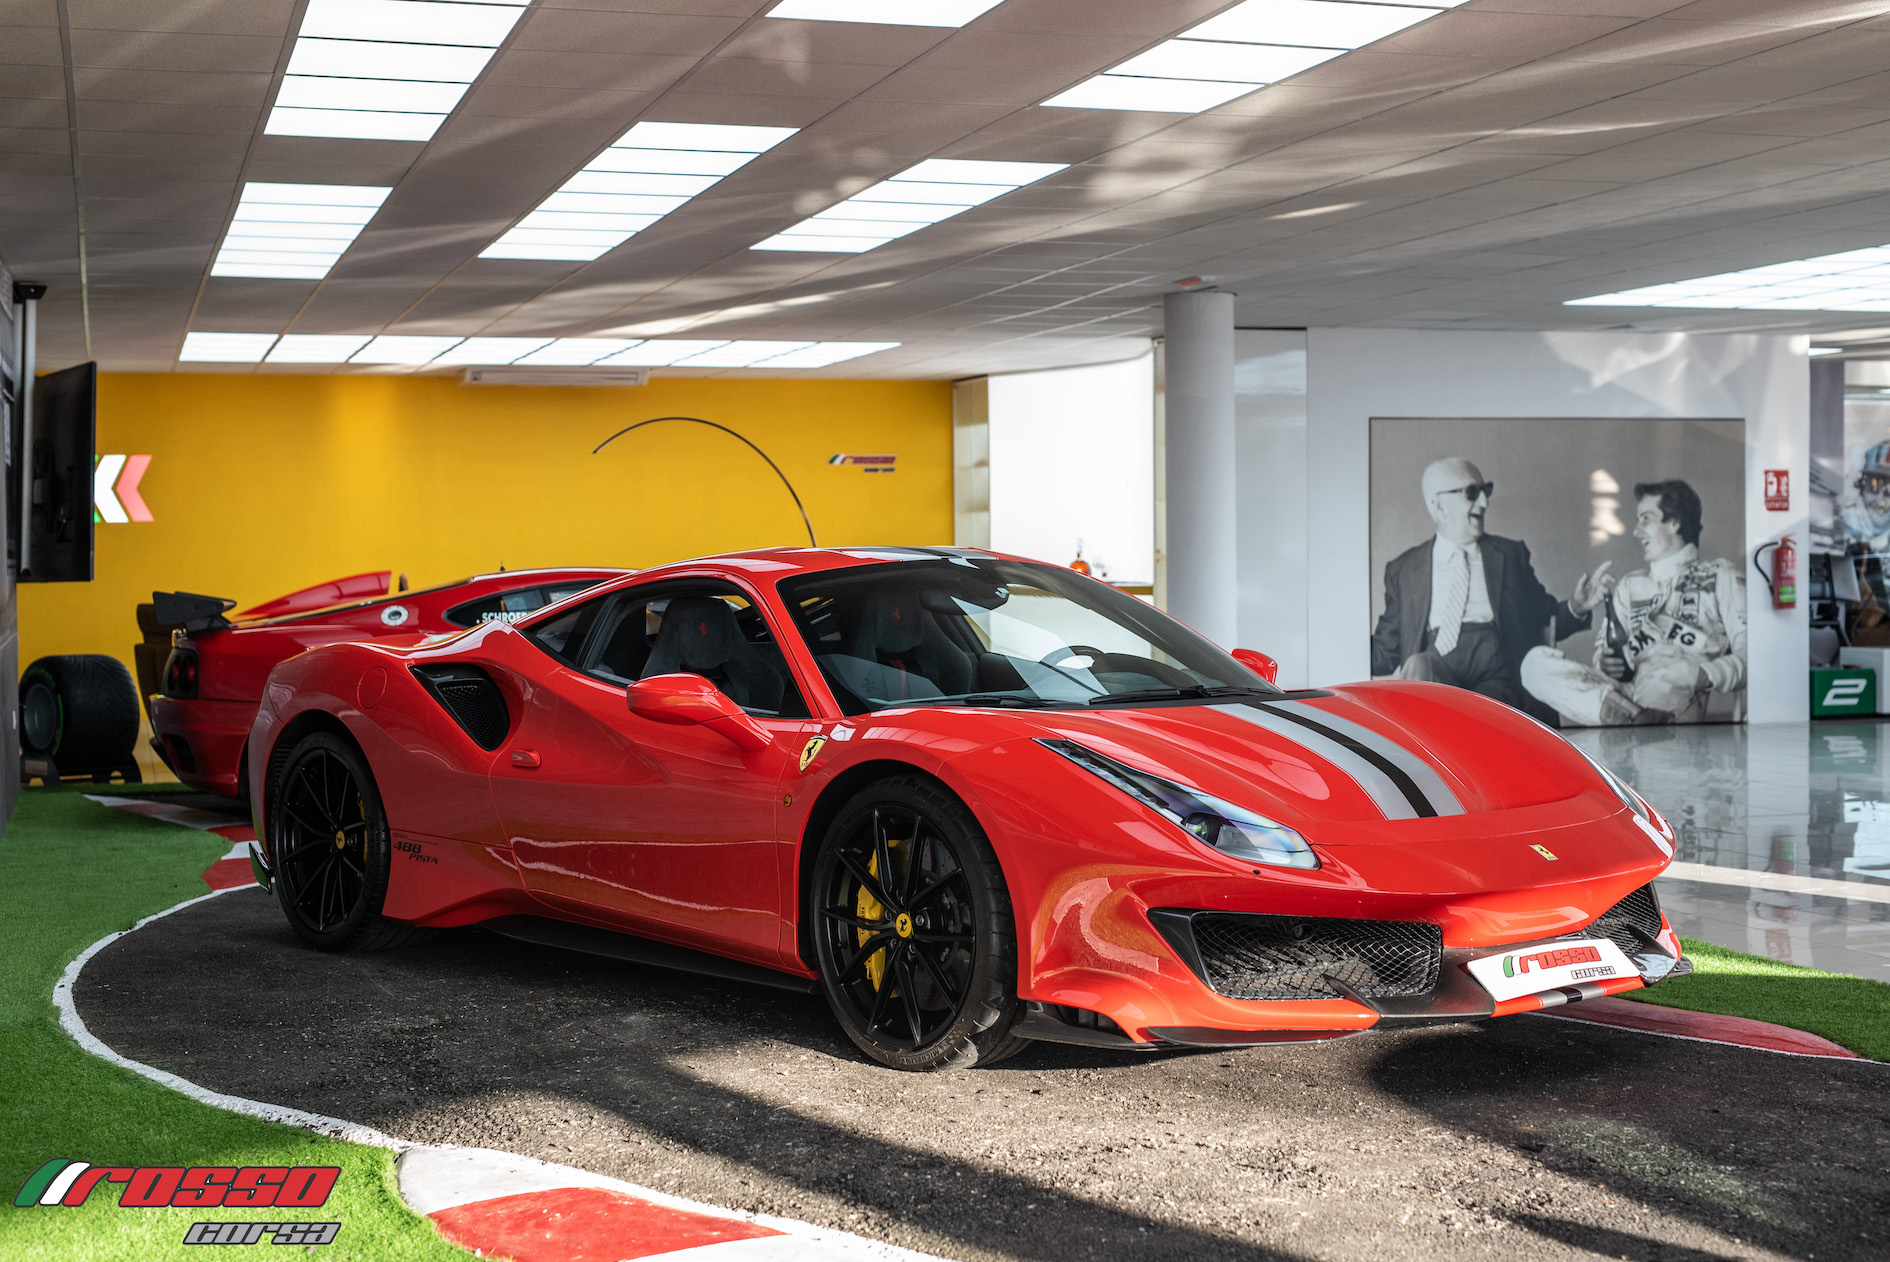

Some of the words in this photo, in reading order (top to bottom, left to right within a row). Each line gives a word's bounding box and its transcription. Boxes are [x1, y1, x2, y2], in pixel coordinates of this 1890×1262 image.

[1668, 623, 1697, 646] EG
[1822, 678, 1867, 706] 2
[393, 841, 422, 853] 488
[409, 853, 438, 864] PISTA
[1520, 946, 1602, 974] rosso
[1570, 965, 1616, 980] corsa
